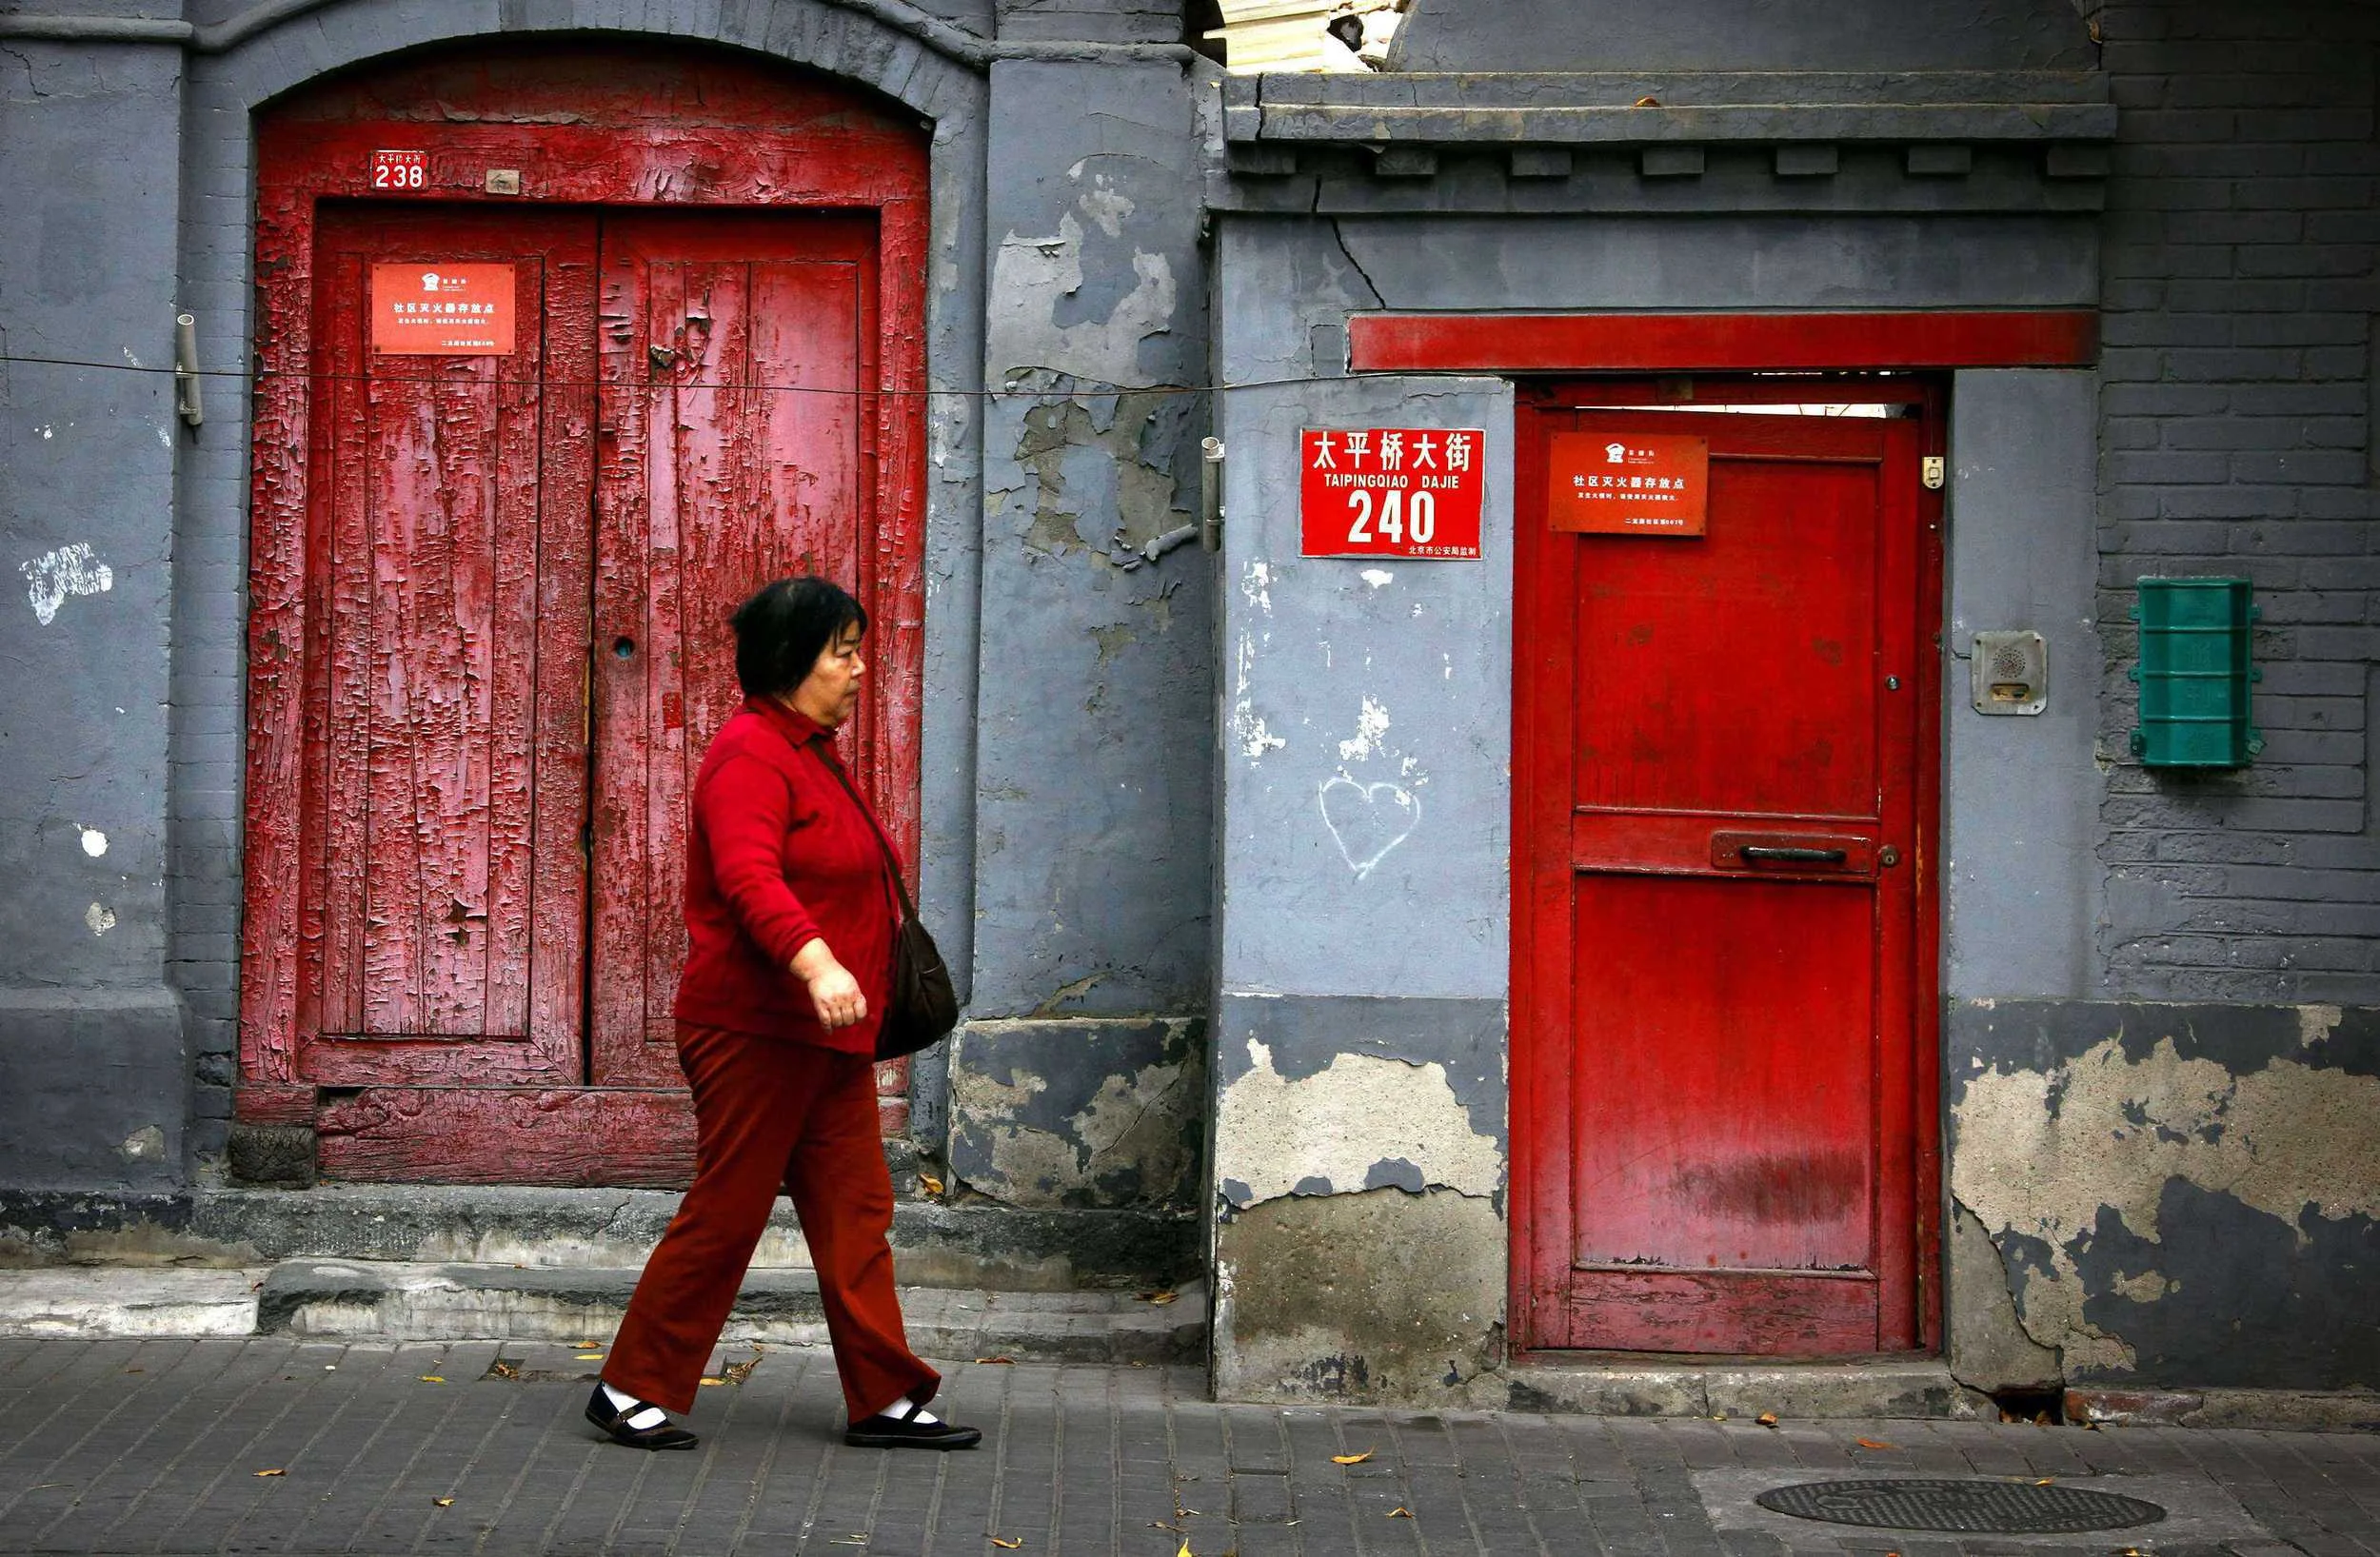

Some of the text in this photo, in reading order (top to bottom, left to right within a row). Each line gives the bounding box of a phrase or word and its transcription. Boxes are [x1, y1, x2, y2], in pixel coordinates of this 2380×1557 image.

[375, 165, 423, 187] 238
[393, 302, 494, 314] 社区灭火器存放点
[1312, 430, 1473, 472] 太平桥大街
[1324, 473, 1459, 489] TAIPINGQIAO DAJIE
[1573, 474, 1685, 490] 社区灭火器存放点
[1347, 489, 1435, 543] 240
[1408, 545, 1477, 557] 北京市公安局监制
